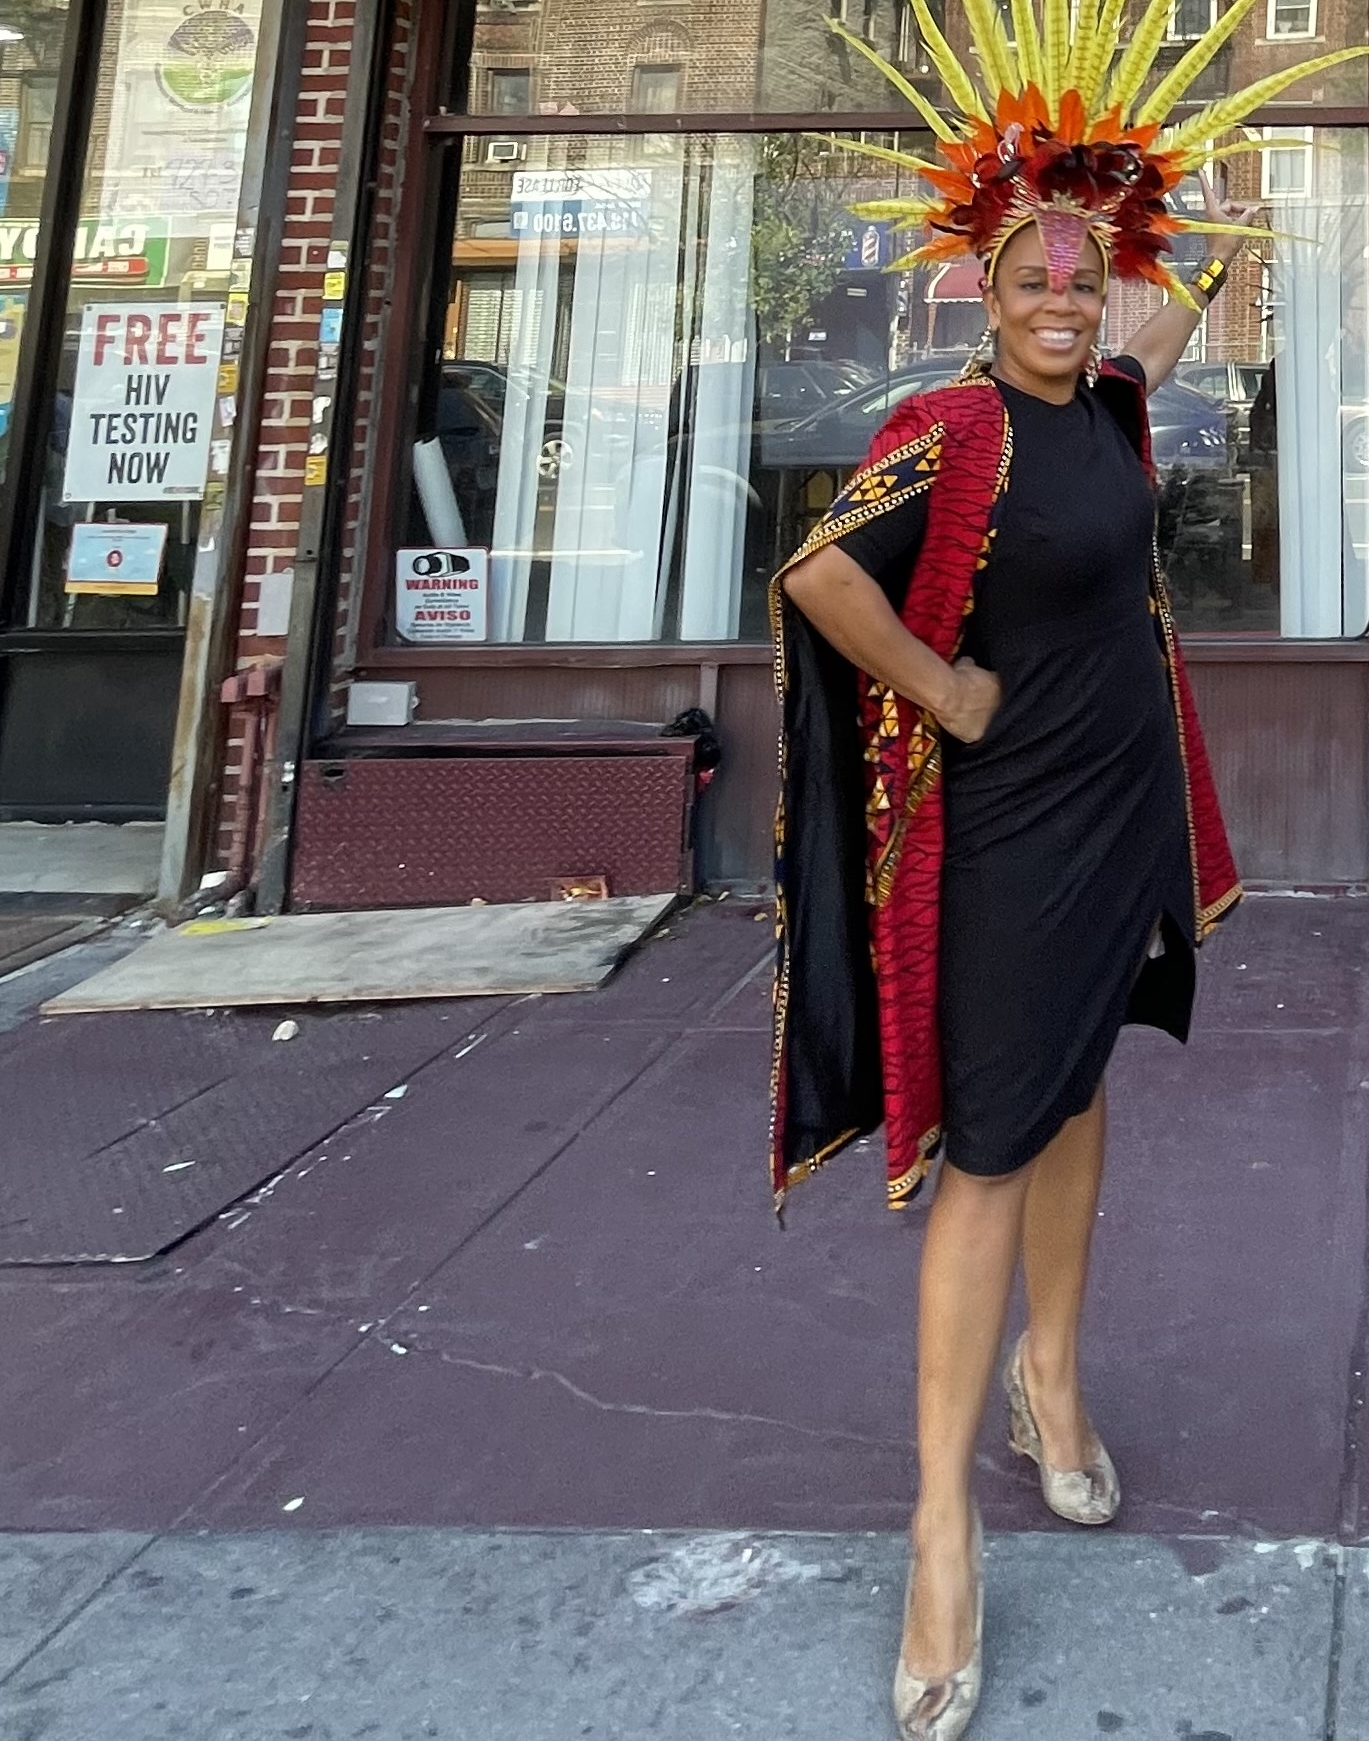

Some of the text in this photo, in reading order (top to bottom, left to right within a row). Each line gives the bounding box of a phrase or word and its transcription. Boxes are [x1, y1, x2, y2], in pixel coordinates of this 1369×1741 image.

[92, 312, 212, 367] FREE
[124, 374, 170, 406] HIV
[90, 411, 198, 446] TESTING
[107, 451, 171, 485] NOW
[405, 579, 479, 591] WARNING
[414, 610, 471, 621] AVISO
